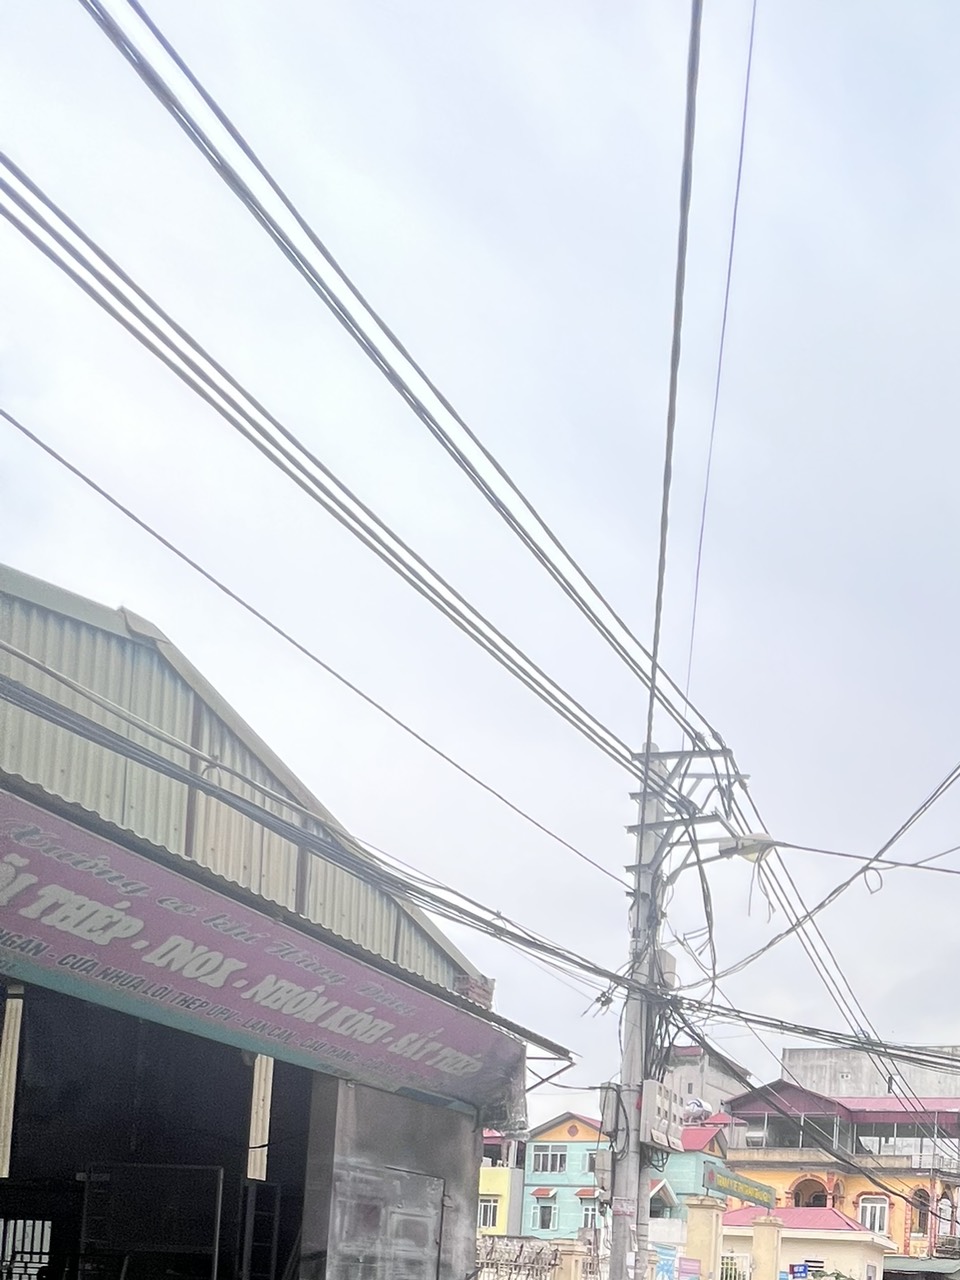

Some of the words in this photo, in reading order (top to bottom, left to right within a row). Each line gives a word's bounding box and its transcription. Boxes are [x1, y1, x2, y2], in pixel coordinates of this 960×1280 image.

[17, 883, 146, 947] THÉP
[141, 934, 249, 989] INOX
[240, 973, 341, 1024] NHÔM
[317, 1005, 397, 1046] KÍNH
